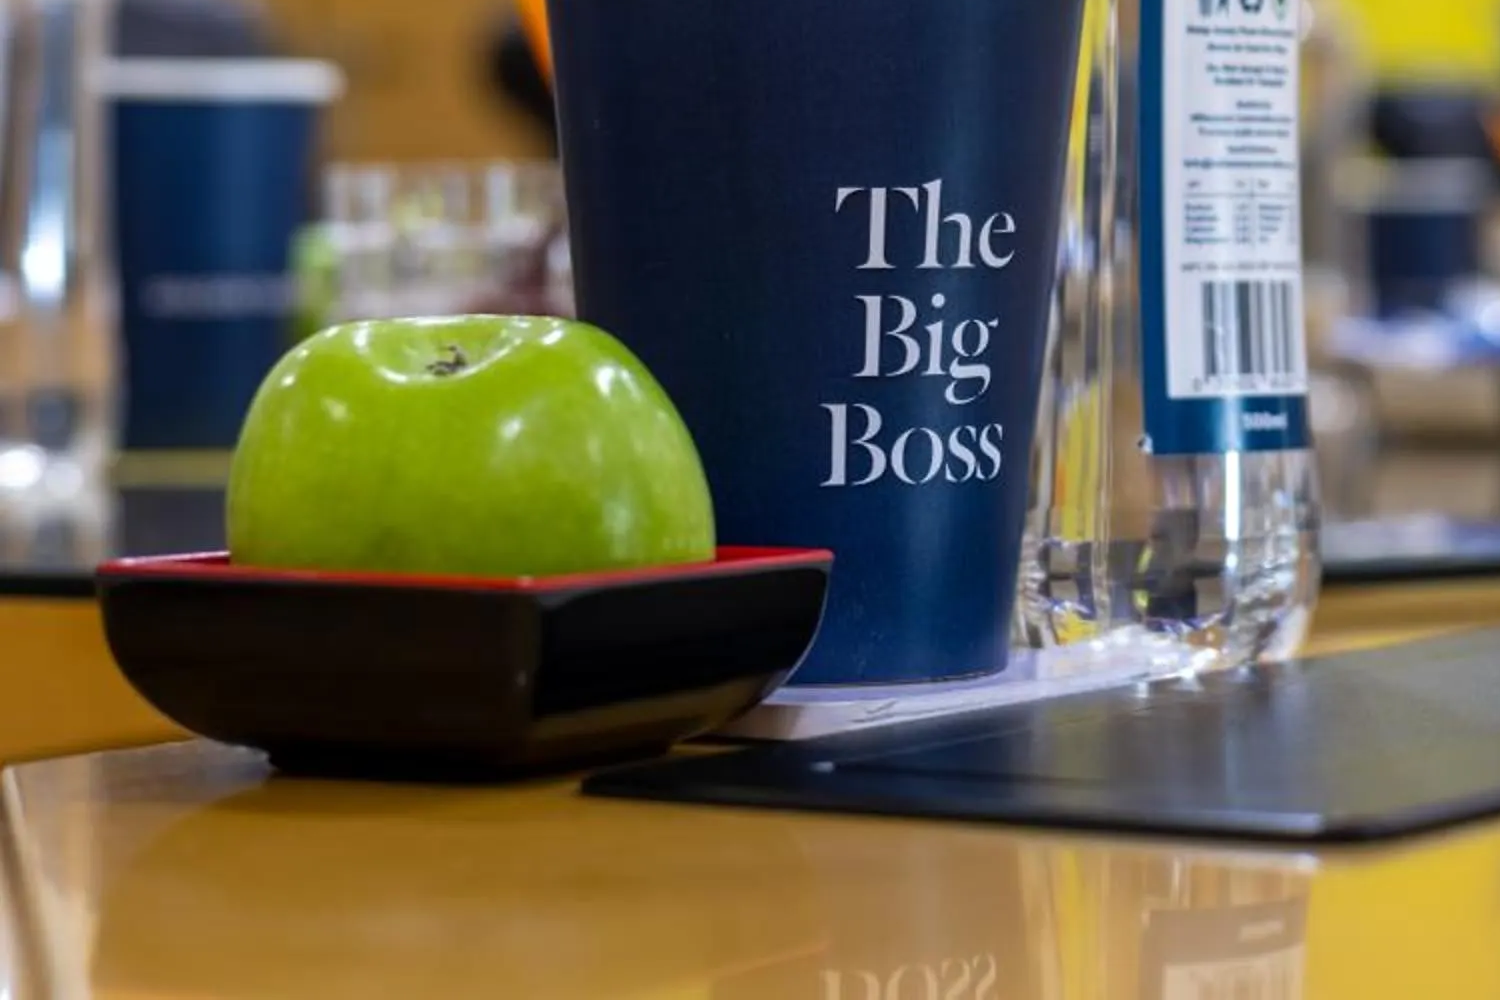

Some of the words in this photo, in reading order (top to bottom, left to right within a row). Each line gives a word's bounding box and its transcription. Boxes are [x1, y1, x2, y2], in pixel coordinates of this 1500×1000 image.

[835, 178, 1016, 269] The
[852, 292, 999, 405] Big
[819, 402, 1003, 487] Boss
